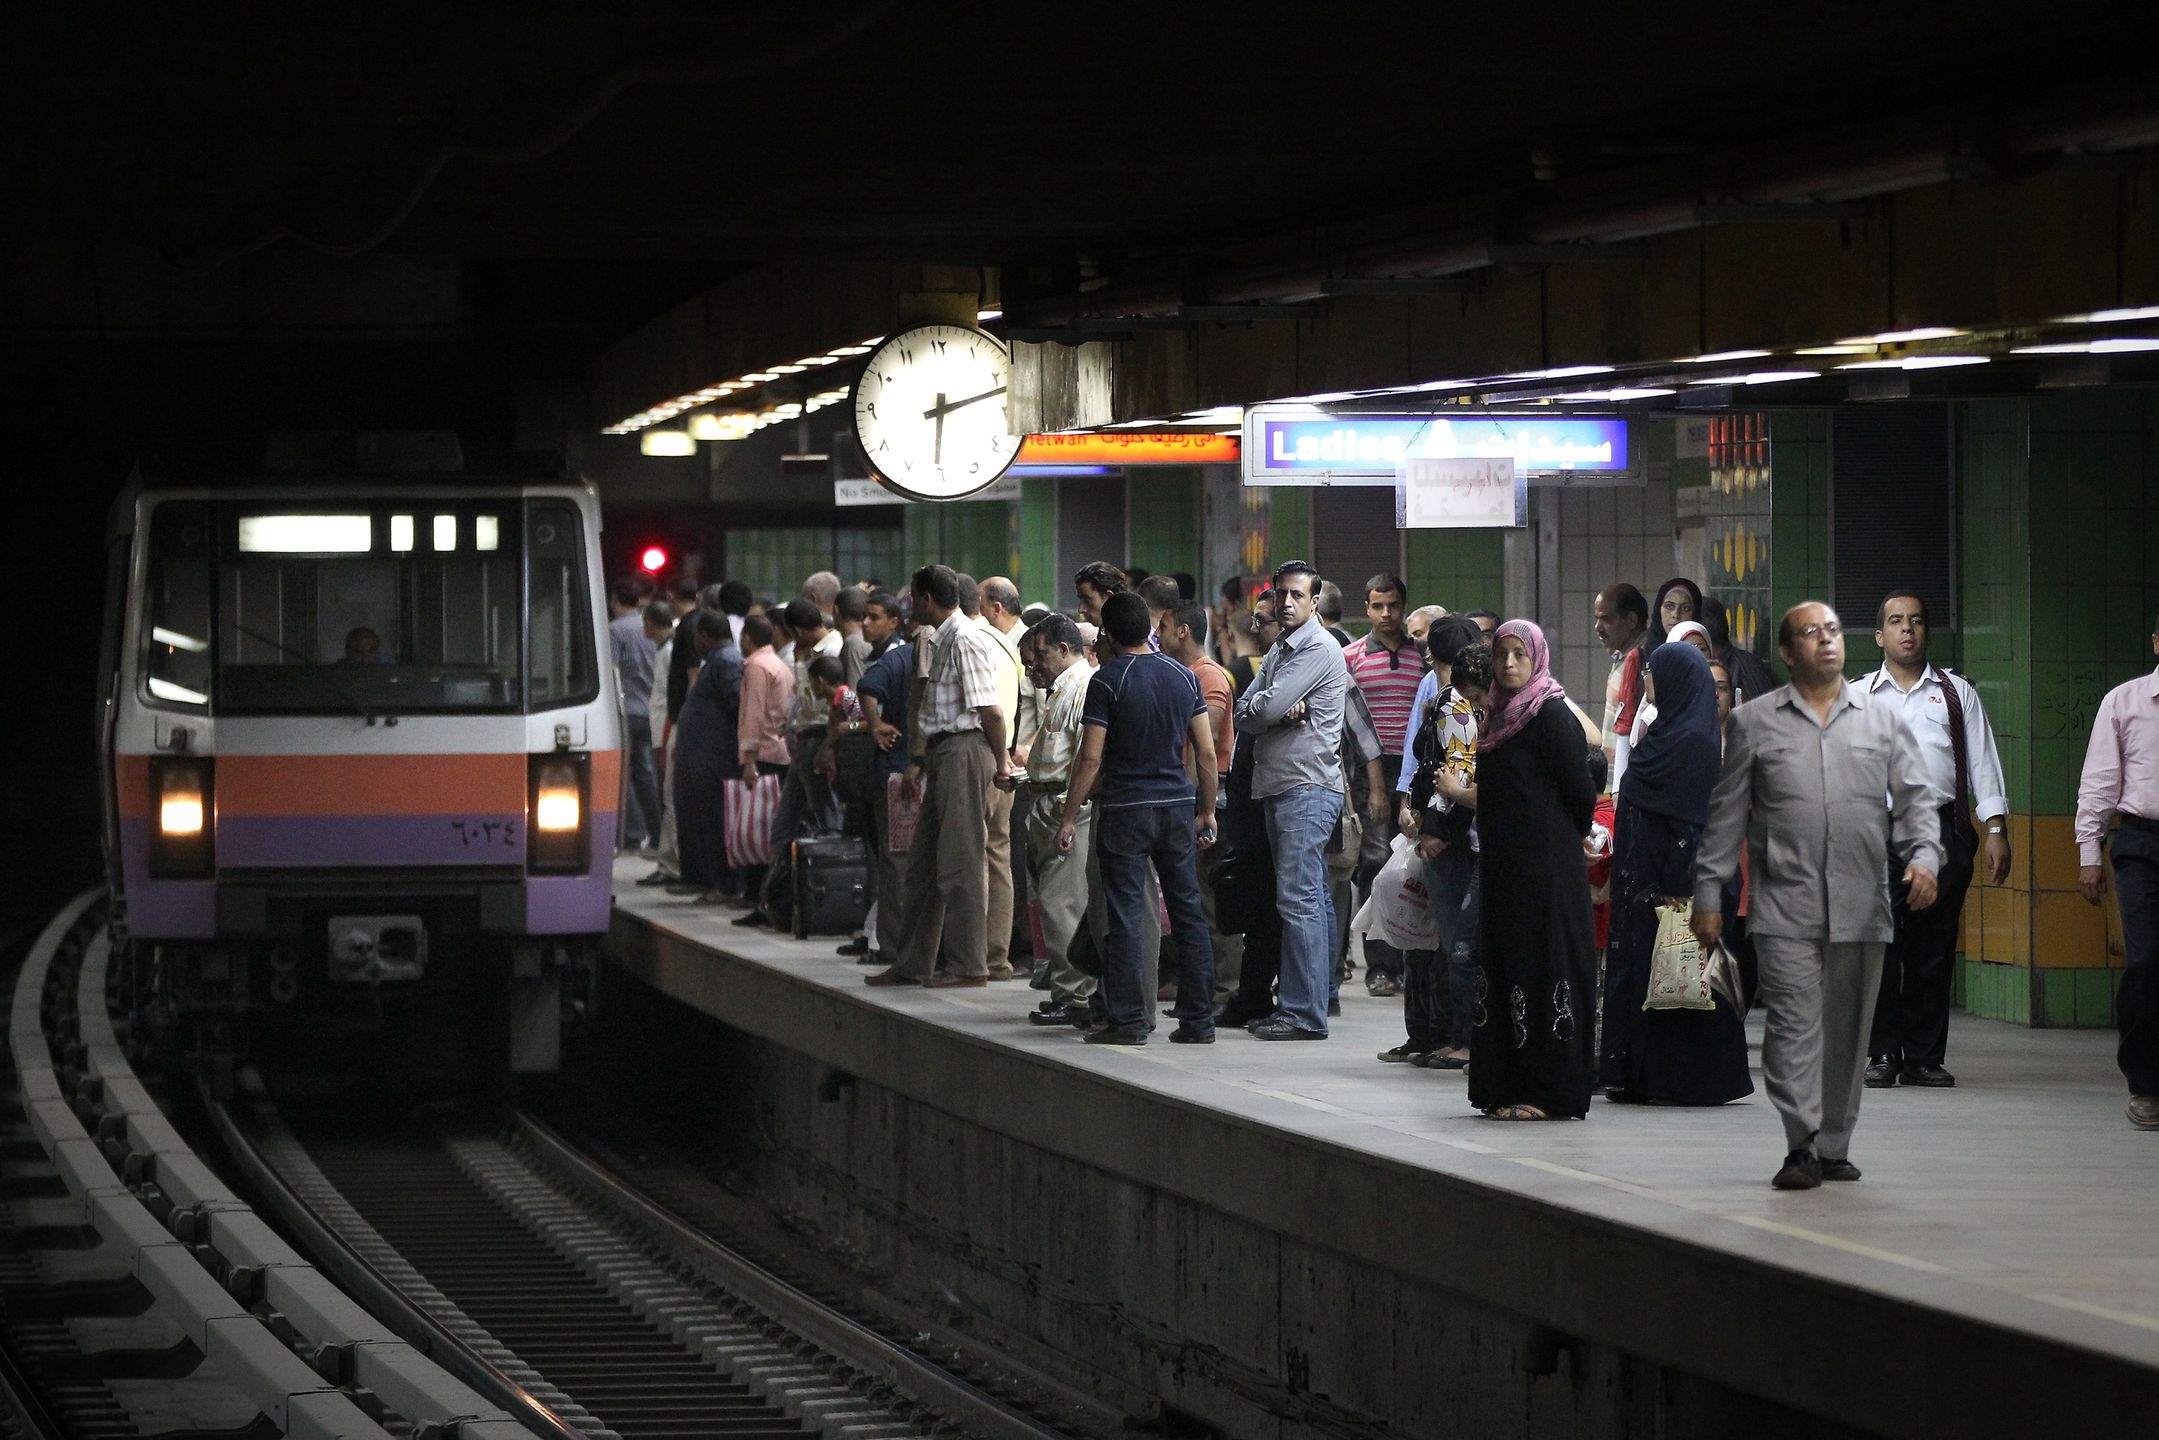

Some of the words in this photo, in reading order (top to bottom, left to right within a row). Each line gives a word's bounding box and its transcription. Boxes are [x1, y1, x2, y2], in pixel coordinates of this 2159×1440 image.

[931, 340, 946, 355] ١٢
[970, 346, 976, 360] ١
[900, 349, 912, 366] ١١
[877, 372, 892, 390] ١٠
[992, 372, 999, 386] ٢
[867, 402, 877, 420] ٩
[879, 439, 889, 451] ٨
[992, 436, 1000, 453] ٤
[1273, 430, 1403, 461] Ladies
[904, 460, 913, 471] ٧
[968, 462, 979, 474] ٥
[936, 467, 945, 481] ٦
